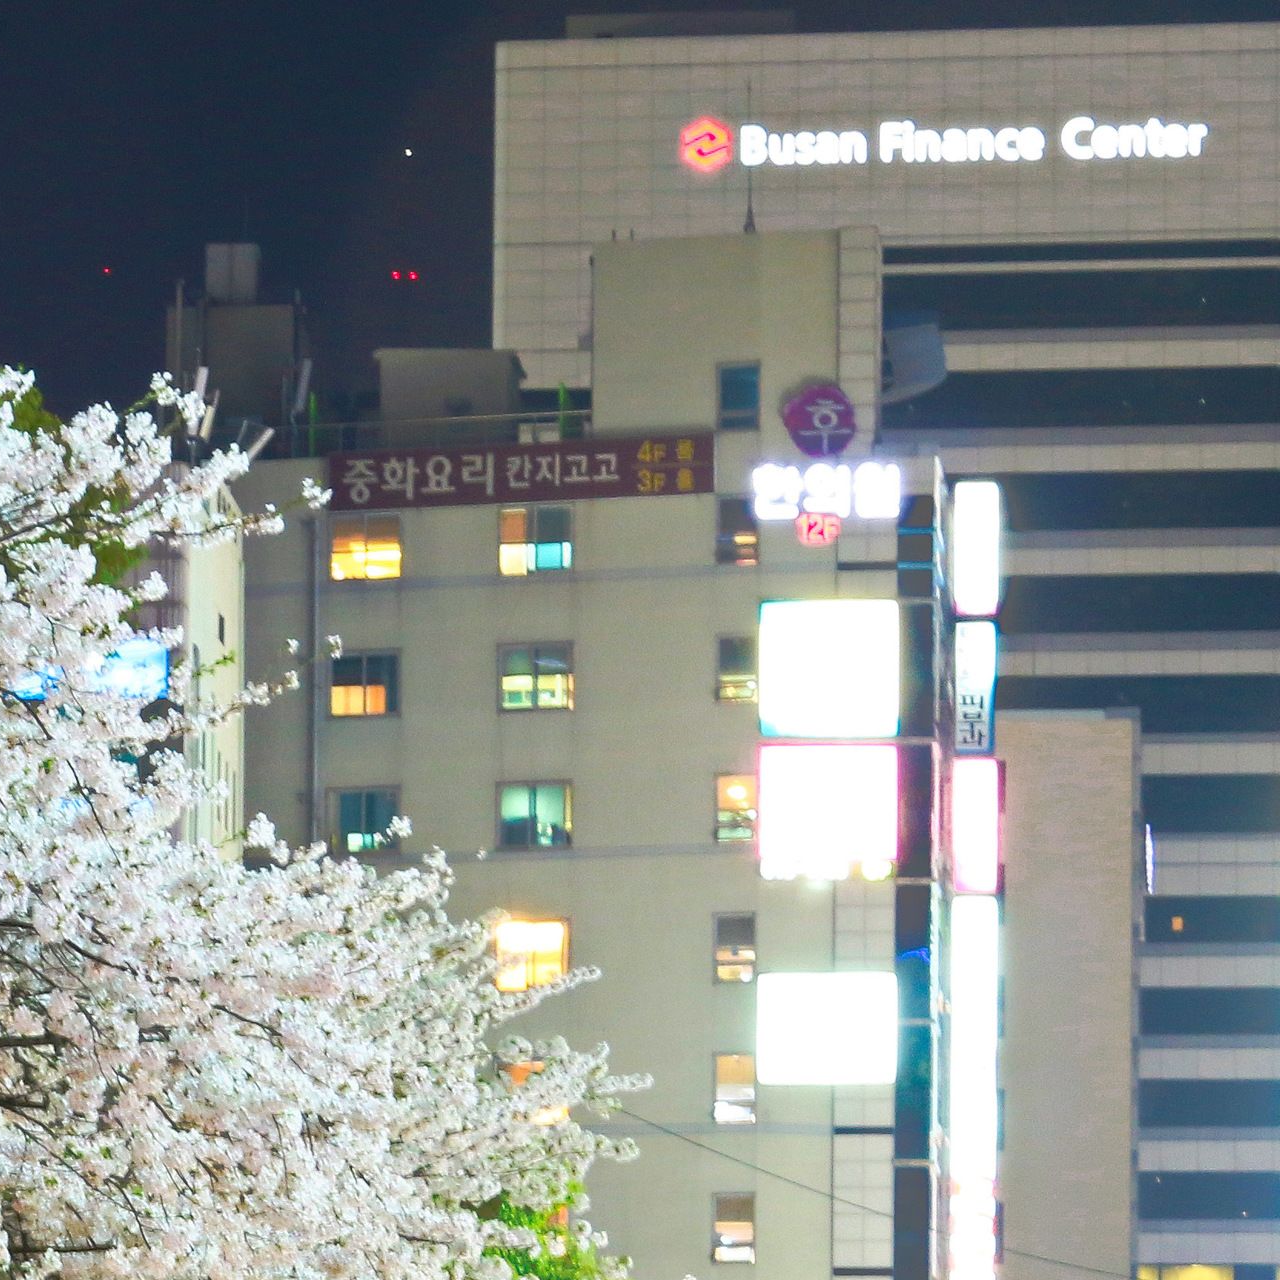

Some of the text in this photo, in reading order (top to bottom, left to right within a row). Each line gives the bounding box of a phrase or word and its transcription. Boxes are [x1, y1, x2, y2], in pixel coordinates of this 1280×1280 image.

[740, 115, 1209, 167] Busan Finance Center
[797, 398, 853, 455] 후
[636, 440, 666, 462] 4F
[341, 451, 620, 503] 중화요리 칸지고고
[637, 468, 666, 492] 3F
[794, 513, 841, 546] 12F
